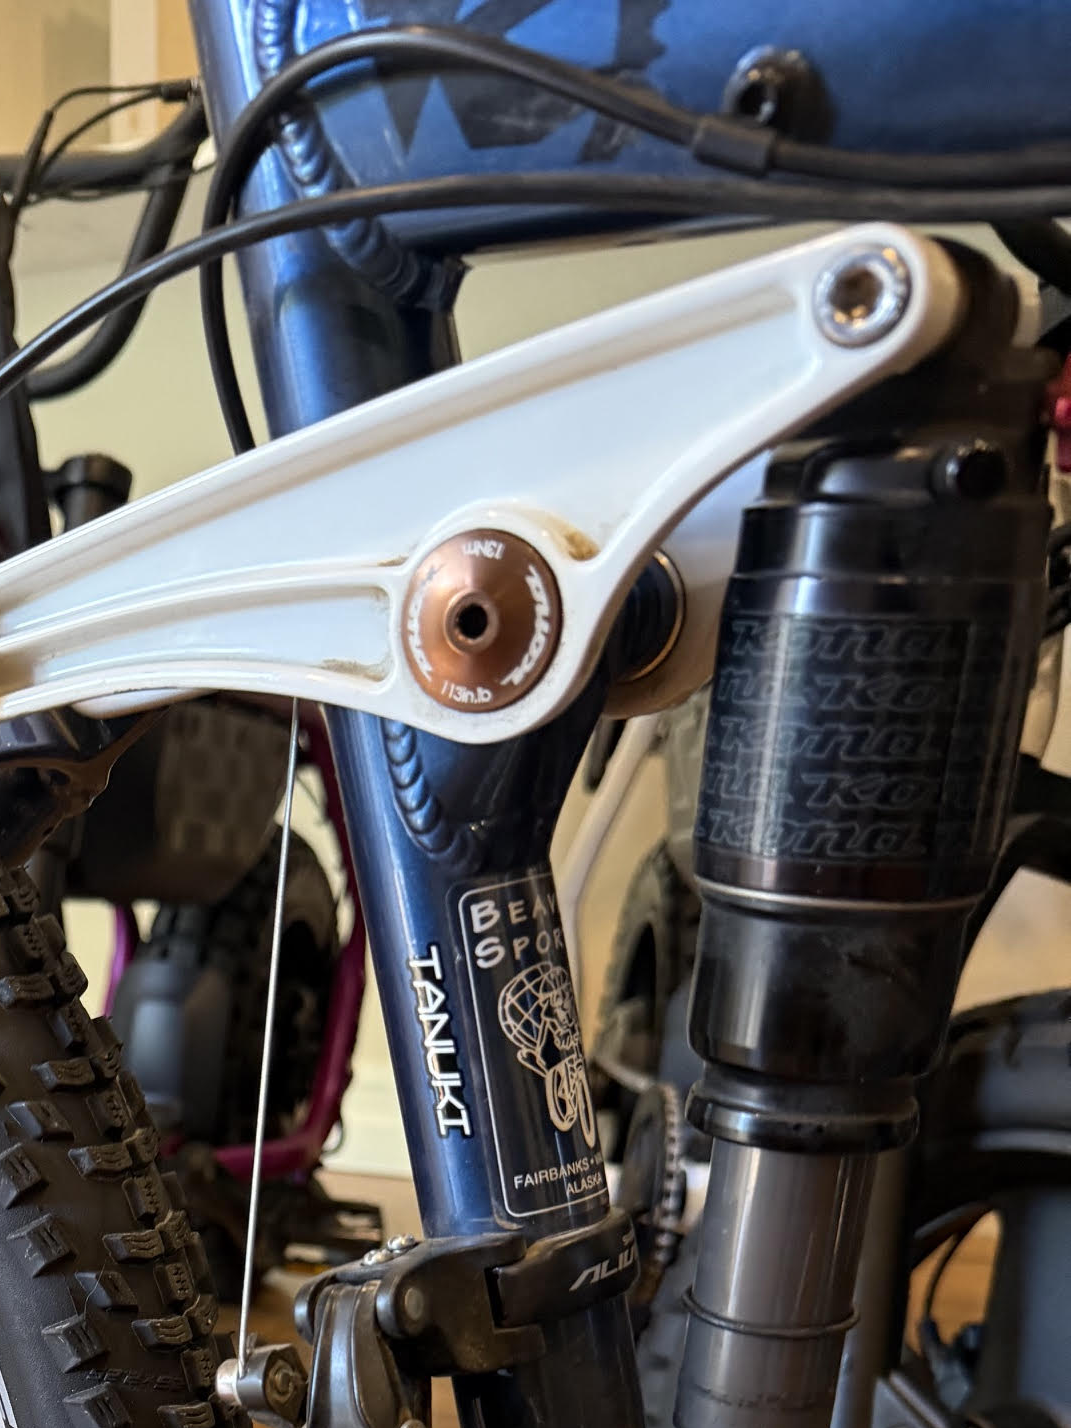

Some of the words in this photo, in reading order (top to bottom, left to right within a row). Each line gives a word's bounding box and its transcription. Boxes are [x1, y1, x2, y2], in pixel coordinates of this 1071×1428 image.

[461, 540, 506, 561] 13Nm
[409, 945, 472, 1136] TANUKI
[513, 1156, 590, 1190] FAIRBANKS
[566, 1171, 602, 1195] ALASKA
